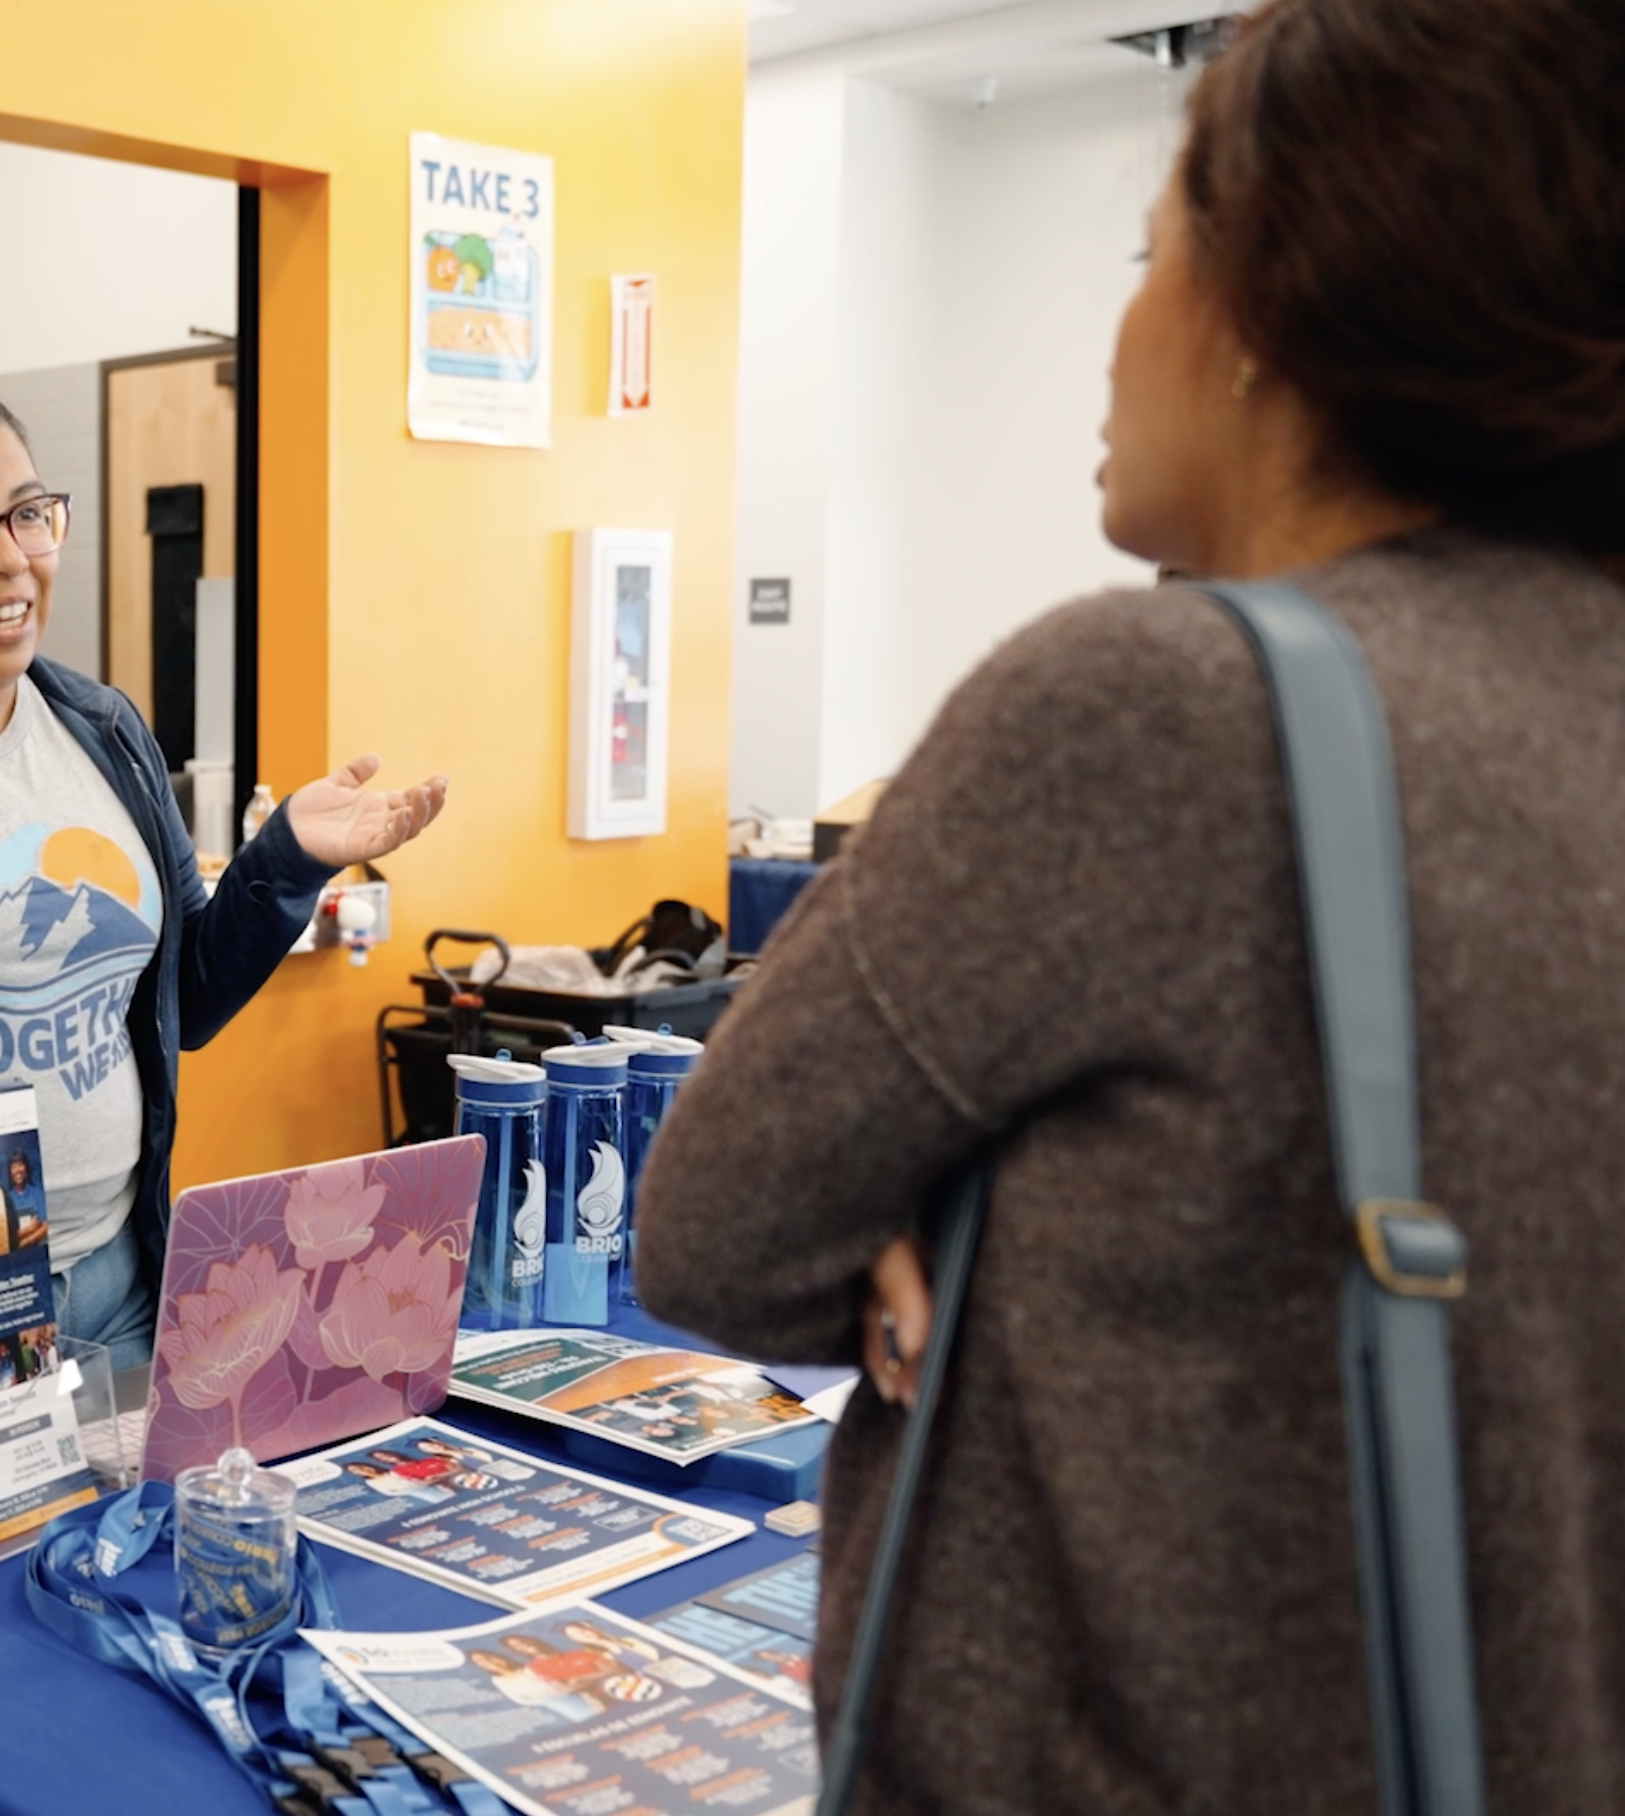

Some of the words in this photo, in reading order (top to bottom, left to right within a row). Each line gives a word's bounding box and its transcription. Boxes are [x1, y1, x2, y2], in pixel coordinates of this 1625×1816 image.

[421, 159, 511, 214] TAKE
[522, 178, 539, 218] 3
[576, 1234, 622, 1253] BRIO
